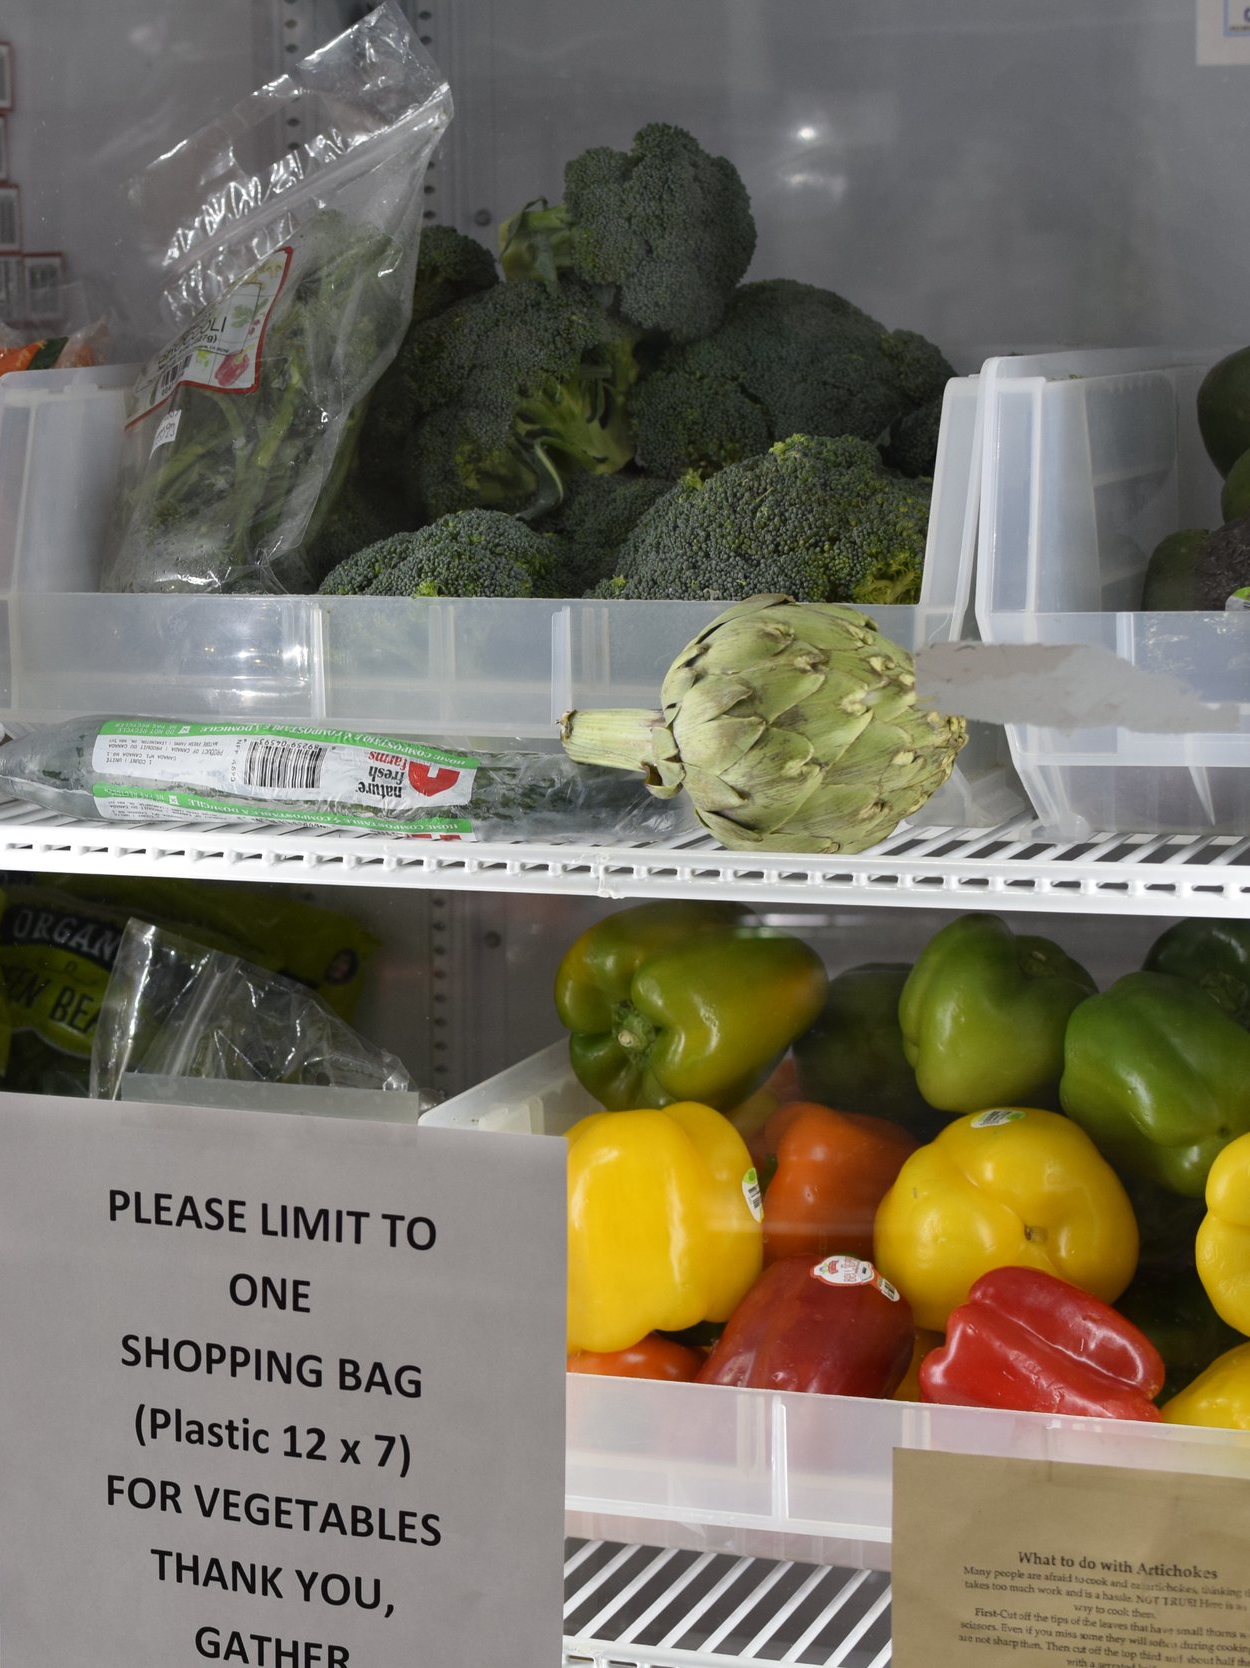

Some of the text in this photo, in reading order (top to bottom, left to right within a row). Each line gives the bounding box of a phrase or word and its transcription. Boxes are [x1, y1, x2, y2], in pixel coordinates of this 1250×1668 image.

[368, 751, 408, 771] farms
[368, 766, 405, 786] fresh
[358, 781, 402, 799] nature
[12, 909, 119, 961] ORGAN
[109, 1189, 437, 1251] PLEASE LIMIT TO
[229, 1273, 311, 1313] ONE
[121, 1334, 422, 1398] SHOPPING BAG
[135, 1404, 411, 1478] (Plastic 12 x 7)
[107, 1474, 442, 1547] FOR VEGETABLES
[963, 1566, 992, 1579] Many
[994, 1569, 1025, 1581] people
[1019, 1551, 1218, 1579] What to do with Artichokes
[150, 1549, 394, 1619] THANK YOU,
[964, 1580, 1083, 1598] takes too much work and
[1001, 1623, 1023, 1634] Even
[1034, 1627, 1053, 1638] you
[1055, 1629, 1077, 1639] miss
[1105, 1633, 1127, 1645] they
[1128, 1637, 1147, 1646] will
[1099, 1619, 1128, 1630] leaves
[1130, 1622, 1149, 1632] that
[195, 1626, 350, 1668] GATHER
